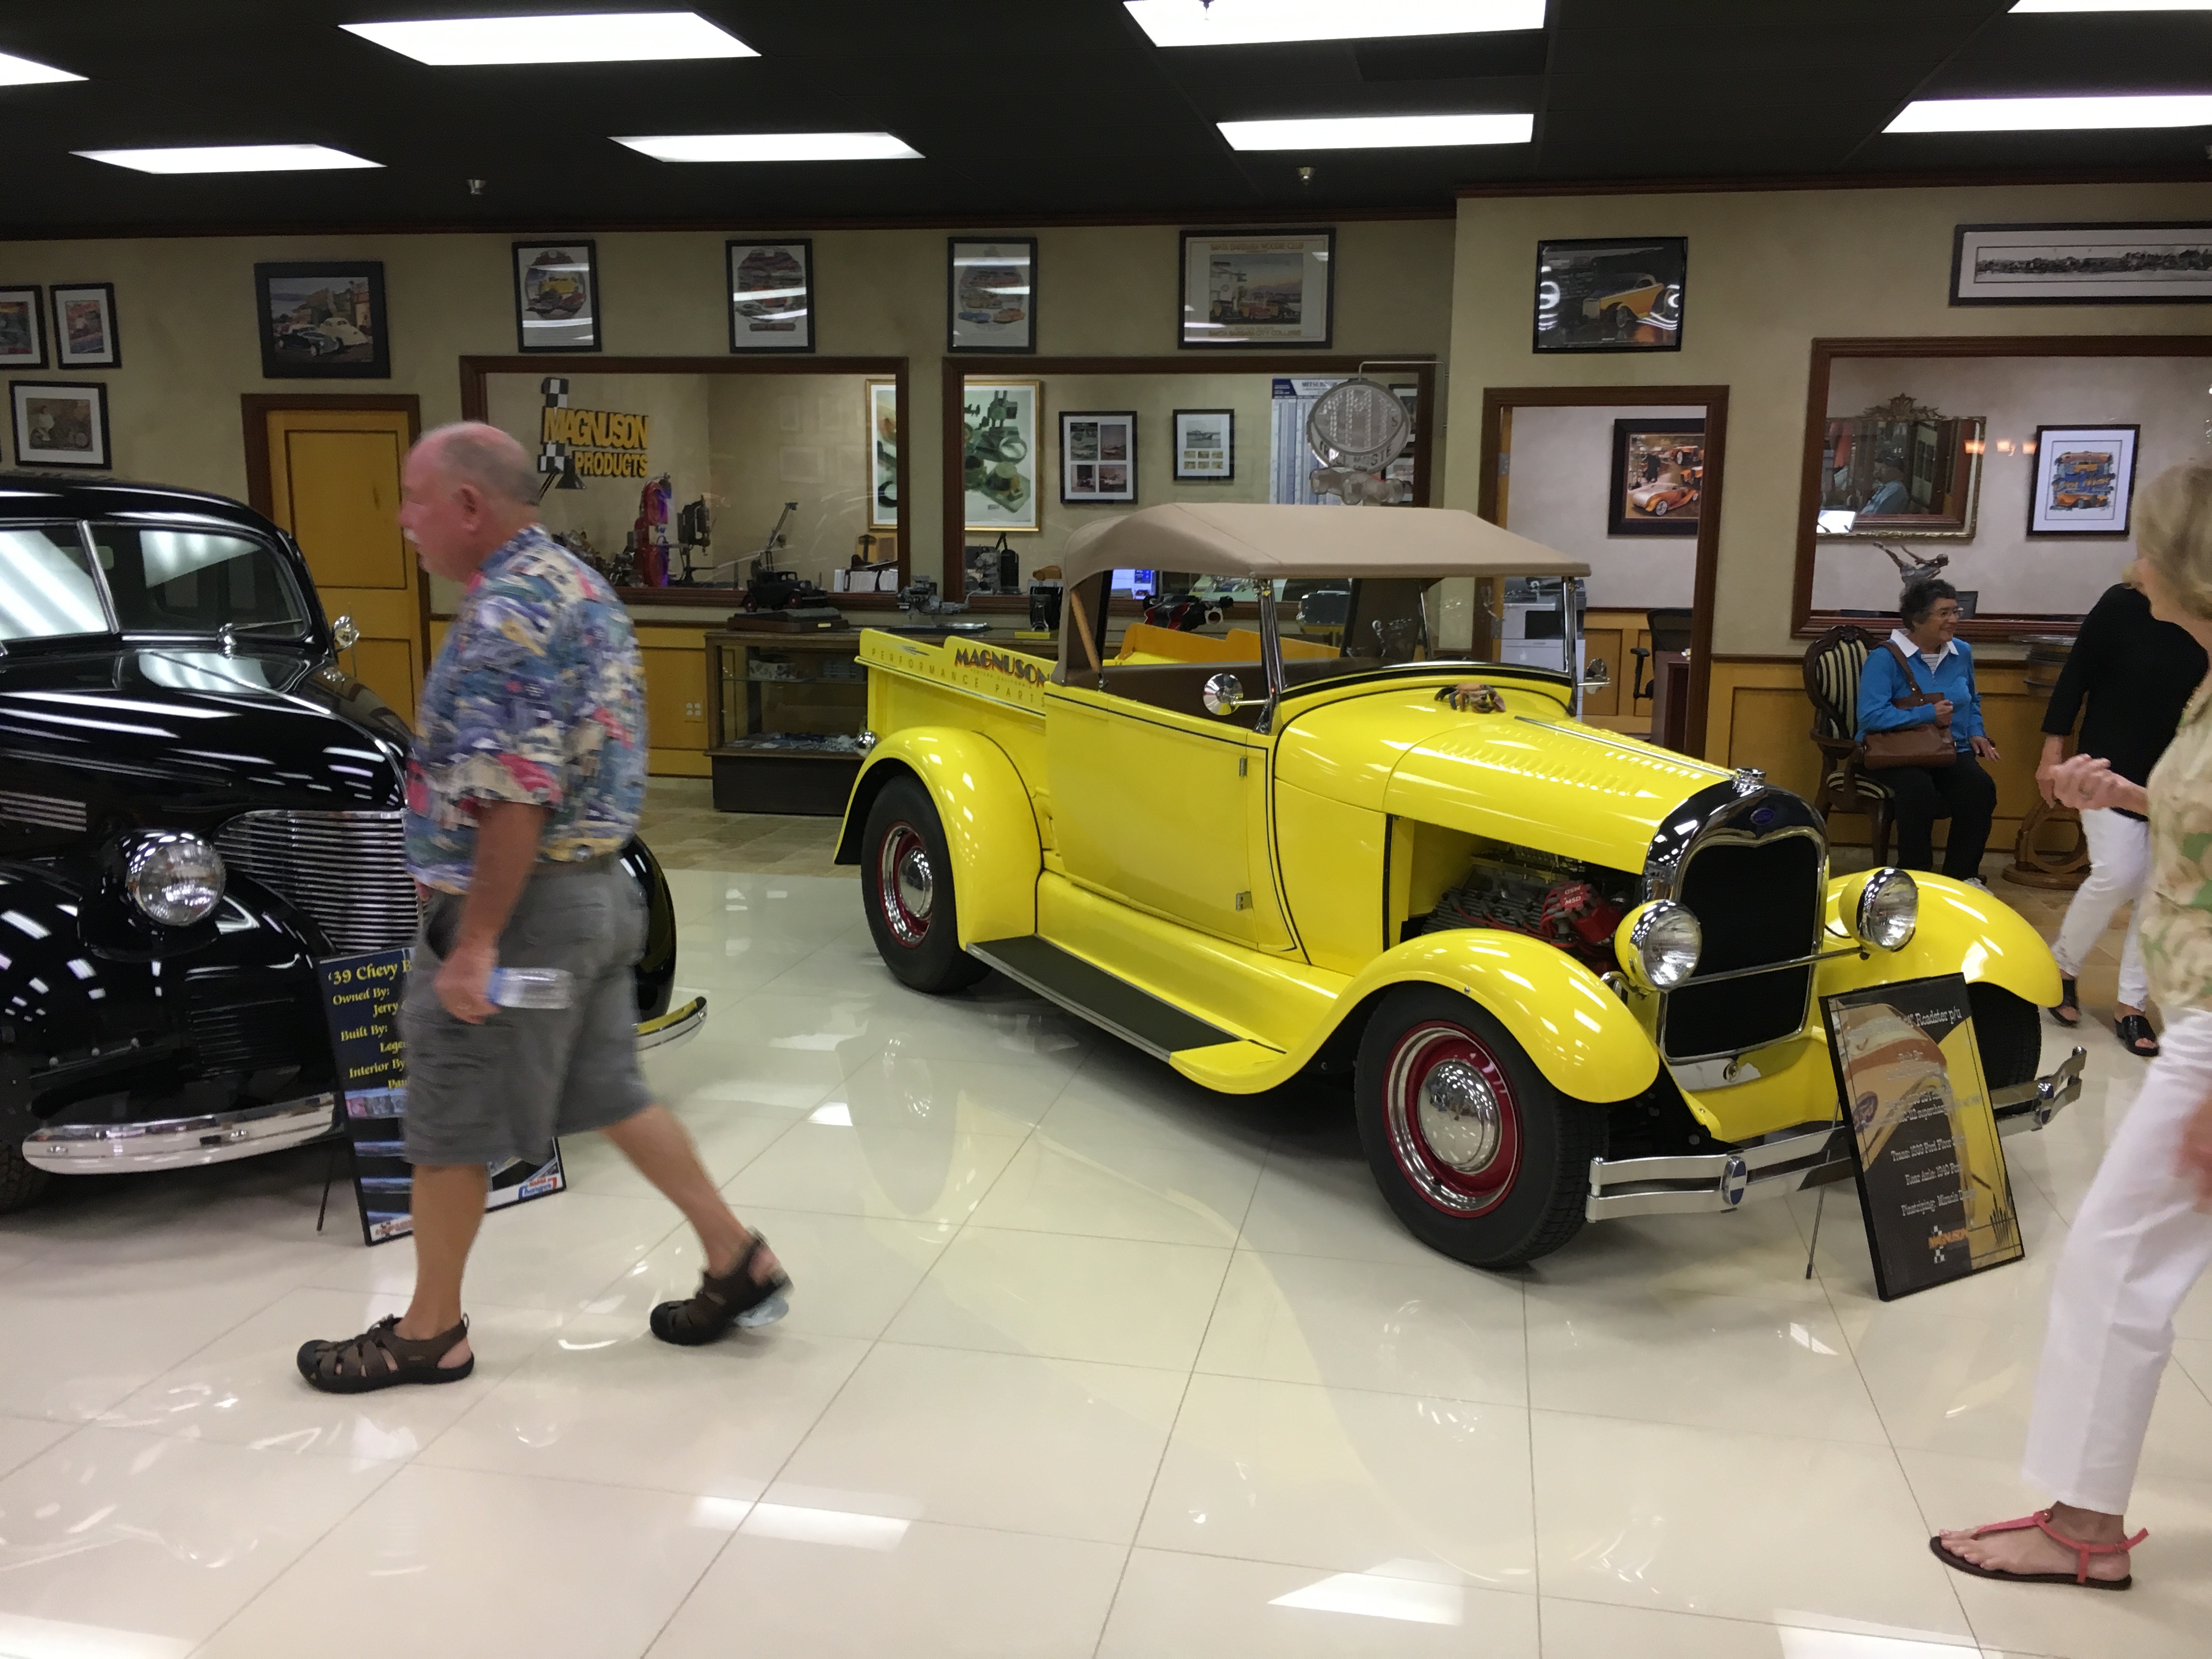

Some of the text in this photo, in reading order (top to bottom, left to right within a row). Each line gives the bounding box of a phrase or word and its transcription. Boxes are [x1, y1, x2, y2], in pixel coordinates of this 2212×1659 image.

[540, 407, 650, 450] MAGNUSON
[573, 450, 649, 478] PRODUCTS
[871, 647, 980, 689] PERFORMANCE
[955, 647, 1051, 689] MAGNUSON
[995, 685, 1046, 708] PARTS
[1565, 896, 1582, 905] MSD
[356, 963, 398, 981] Chevy
[332, 988, 390, 1006] Owned By:
[373, 1002, 399, 1018] Jerry
[1915, 1008, 1948, 1026] Roadster
[341, 1024, 388, 1041] Built By:
[349, 1062, 390, 1079] Interior
